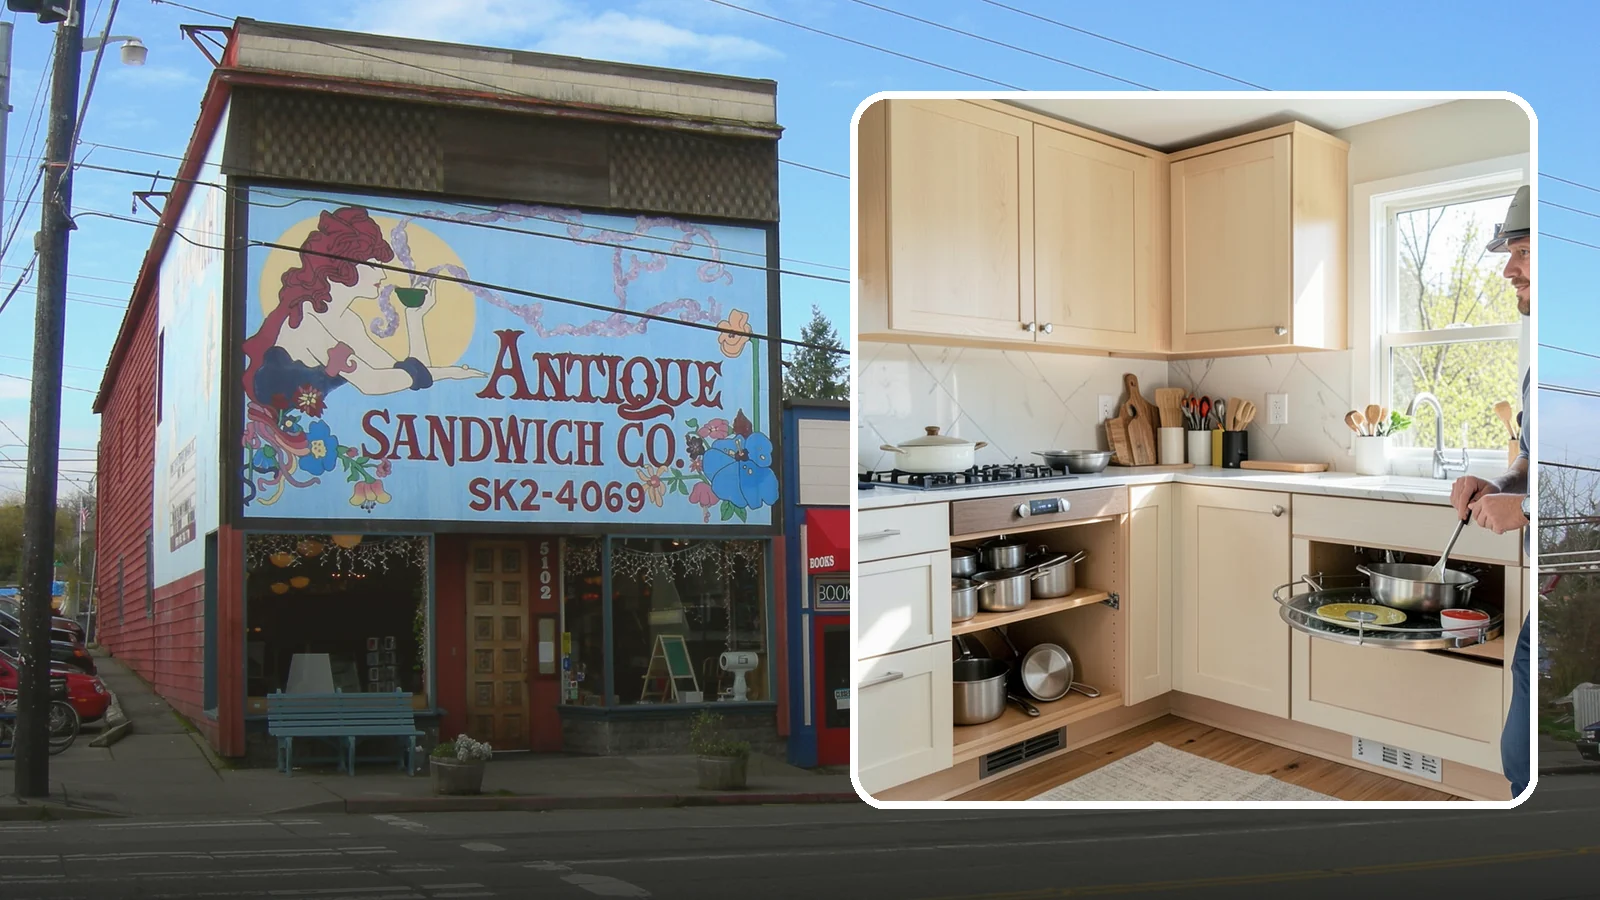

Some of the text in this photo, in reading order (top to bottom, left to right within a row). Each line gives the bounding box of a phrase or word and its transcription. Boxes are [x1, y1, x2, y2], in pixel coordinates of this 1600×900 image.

[476, 329, 723, 420] ANTIQUE
[361, 408, 685, 469] SANDWICH CO.
[468, 477, 645, 512] SK2-4069
[540, 541, 551, 600] 5102
[809, 555, 835, 568] BOOKS
